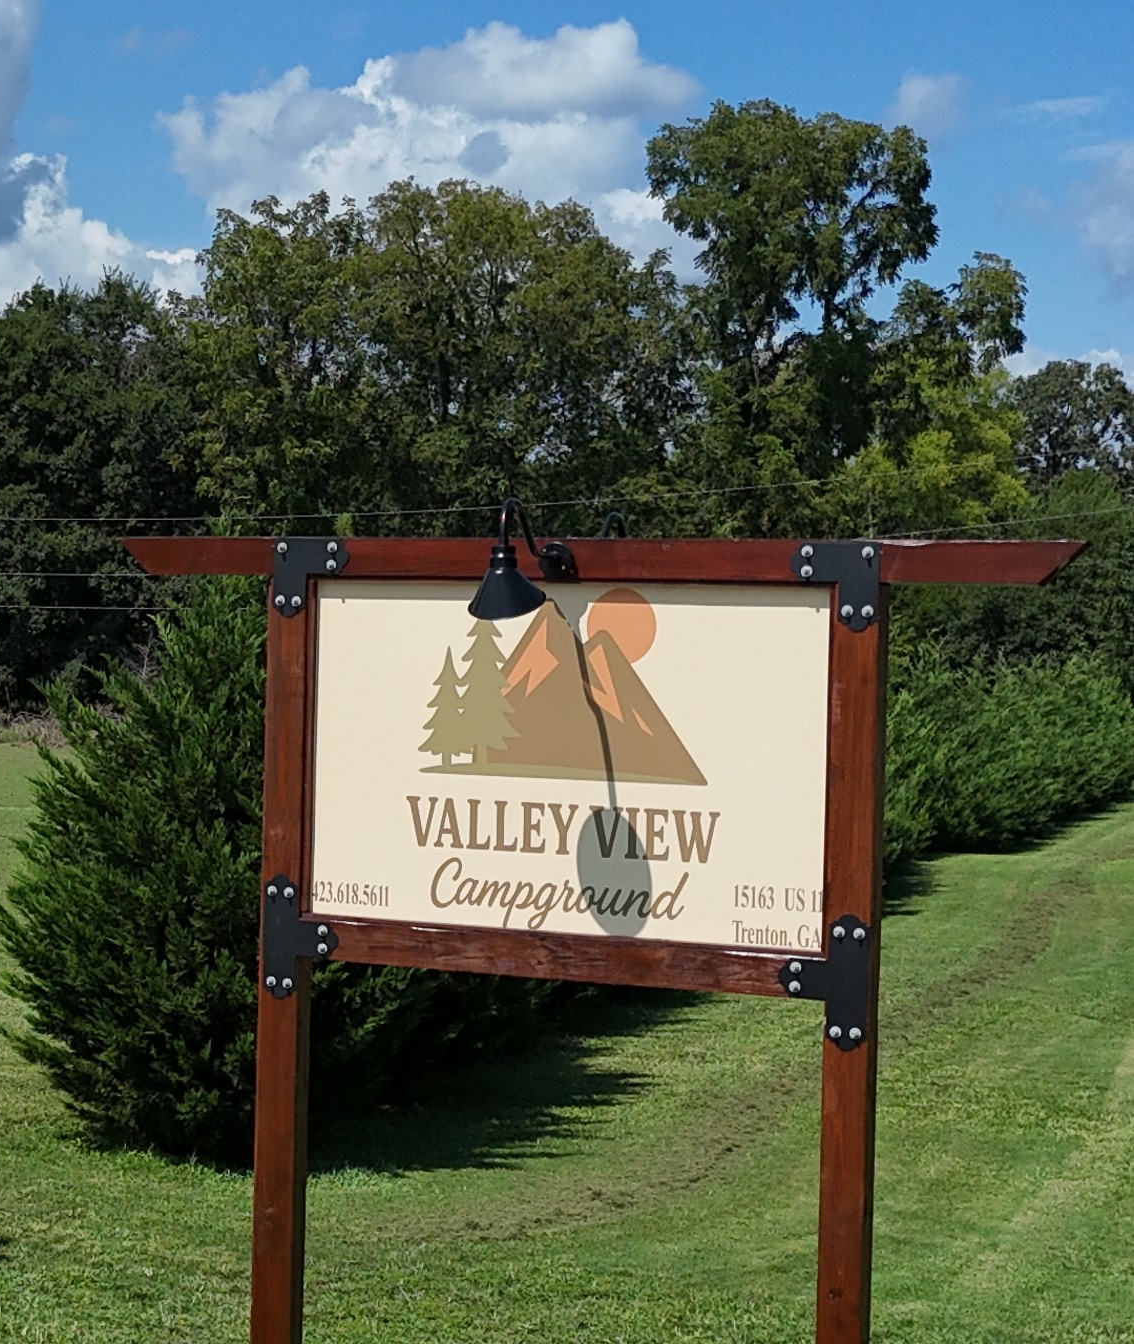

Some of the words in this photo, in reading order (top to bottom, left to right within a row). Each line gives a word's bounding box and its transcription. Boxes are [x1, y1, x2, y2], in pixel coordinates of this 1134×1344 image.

[406, 795, 578, 856] VALLEY
[589, 805, 720, 864] VIEW
[313, 881, 389, 907] 423.618.5611
[430, 856, 690, 929] Campground
[733, 884, 775, 910] 15163
[784, 887, 806, 912] US
[732, 920, 792, 949] Trenton,
[797, 924, 821, 949] GA
